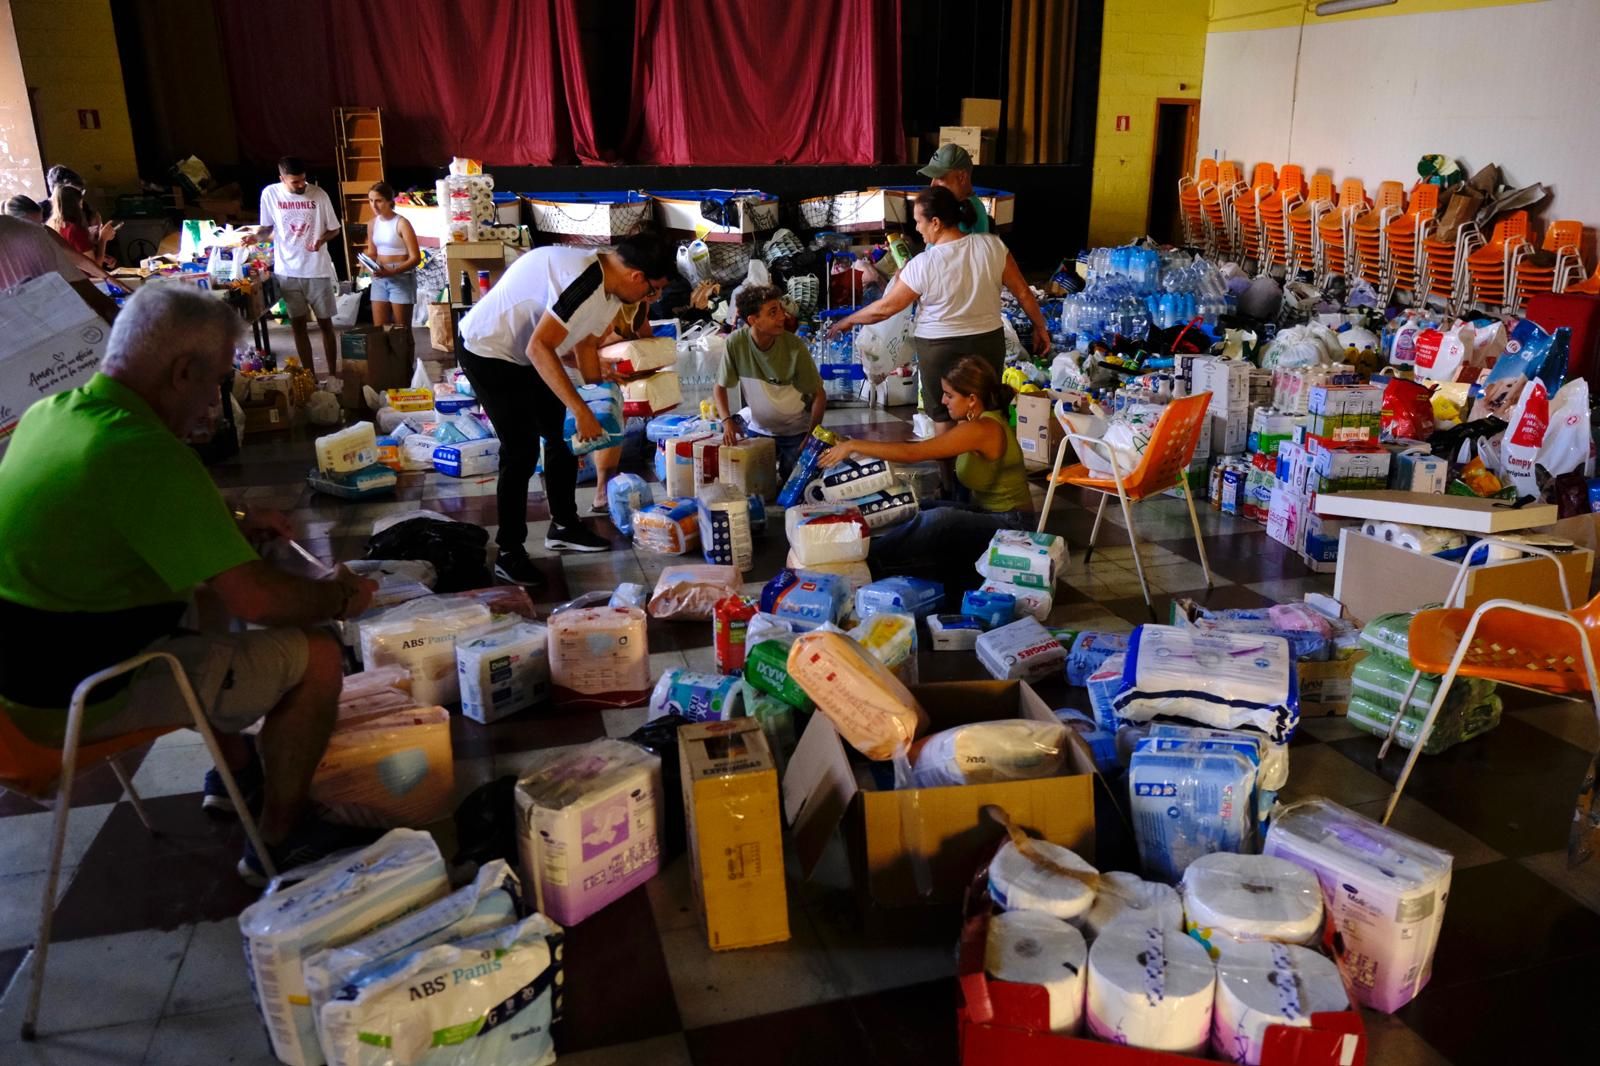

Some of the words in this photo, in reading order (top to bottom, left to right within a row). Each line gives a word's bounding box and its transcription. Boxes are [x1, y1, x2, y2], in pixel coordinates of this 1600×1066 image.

[278, 200, 316, 210] RAMONES
[1508, 455, 1532, 470] Compy
[402, 638, 424, 650] ABS
[1017, 640, 1061, 659] HUGGIES
[756, 661, 787, 683] MAXI
[697, 701, 709, 718] XL
[407, 976, 447, 1002] ABS
